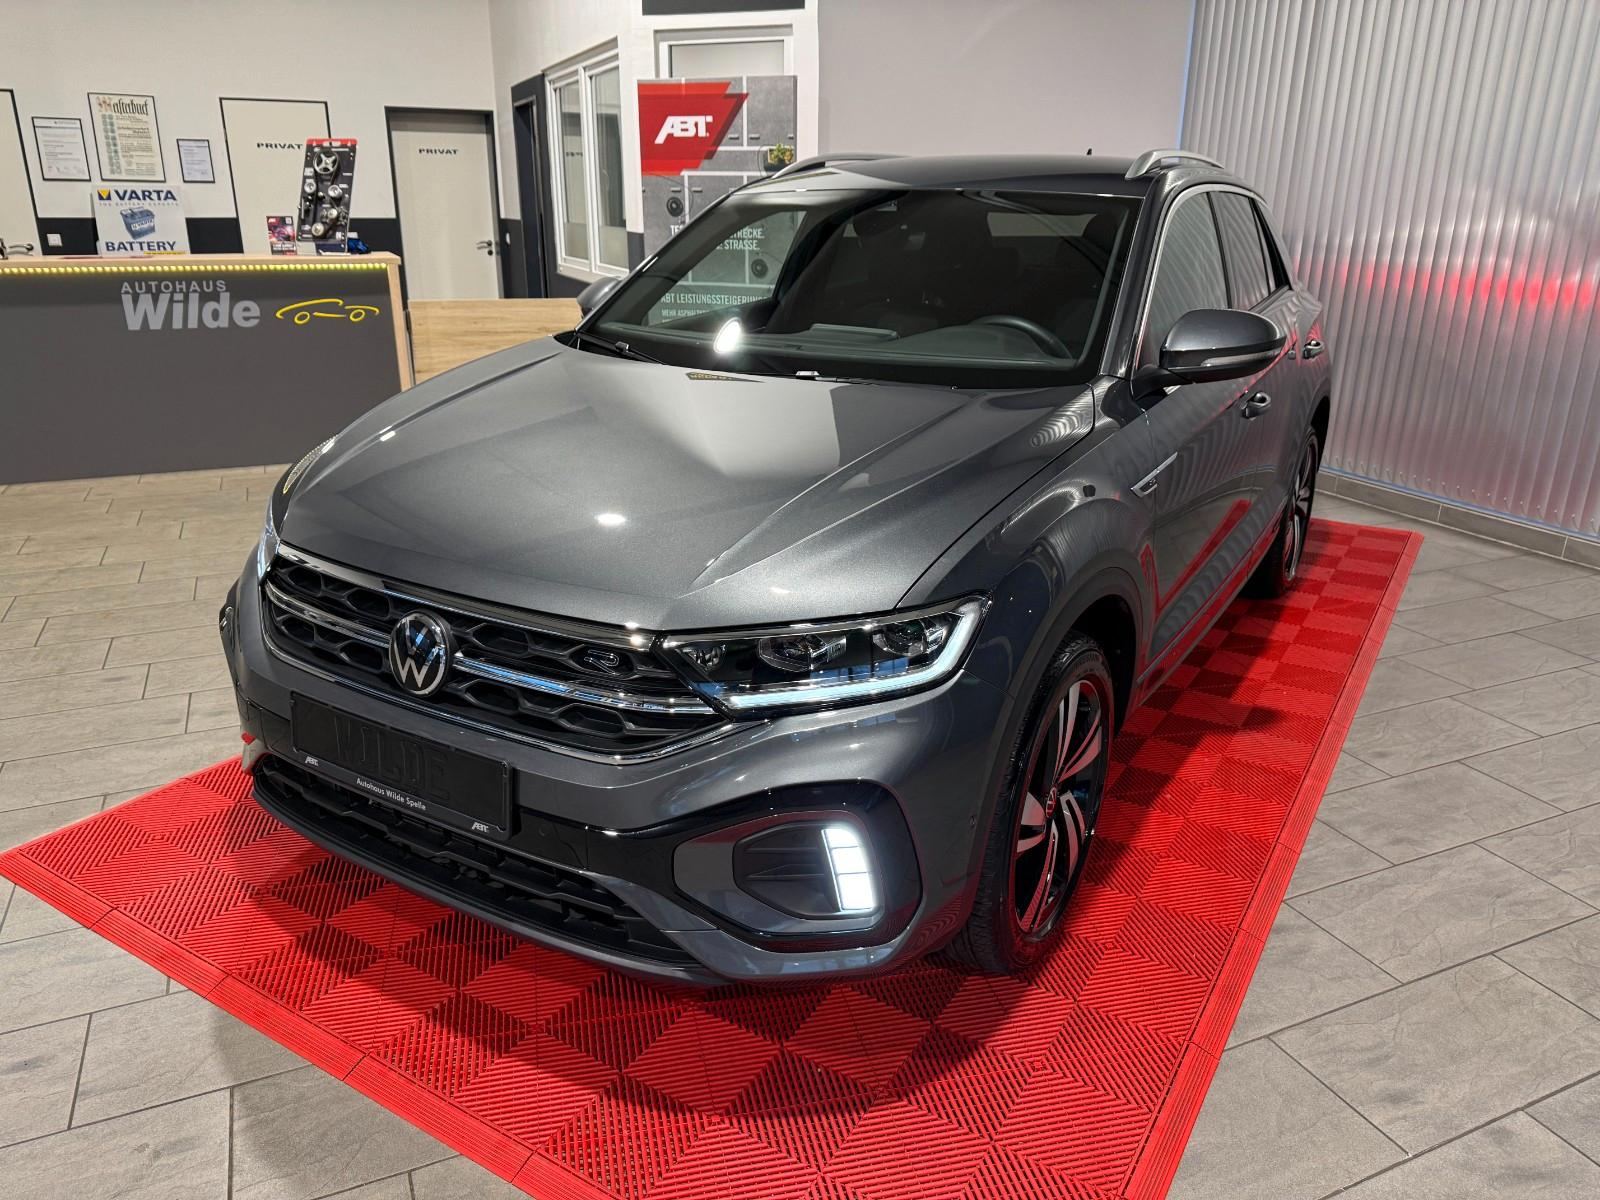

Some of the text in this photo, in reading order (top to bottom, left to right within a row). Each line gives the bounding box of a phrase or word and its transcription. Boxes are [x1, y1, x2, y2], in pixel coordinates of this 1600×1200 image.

[654, 115, 713, 144] ABT
[256, 142, 303, 150] PRIVAT
[113, 189, 177, 201] VARTA
[105, 241, 176, 252] BATTERY
[121, 280, 226, 294] AUTOHAUS
[121, 292, 260, 331] Wilde
[356, 777, 427, 811] Autohaus Wilde Spelle
